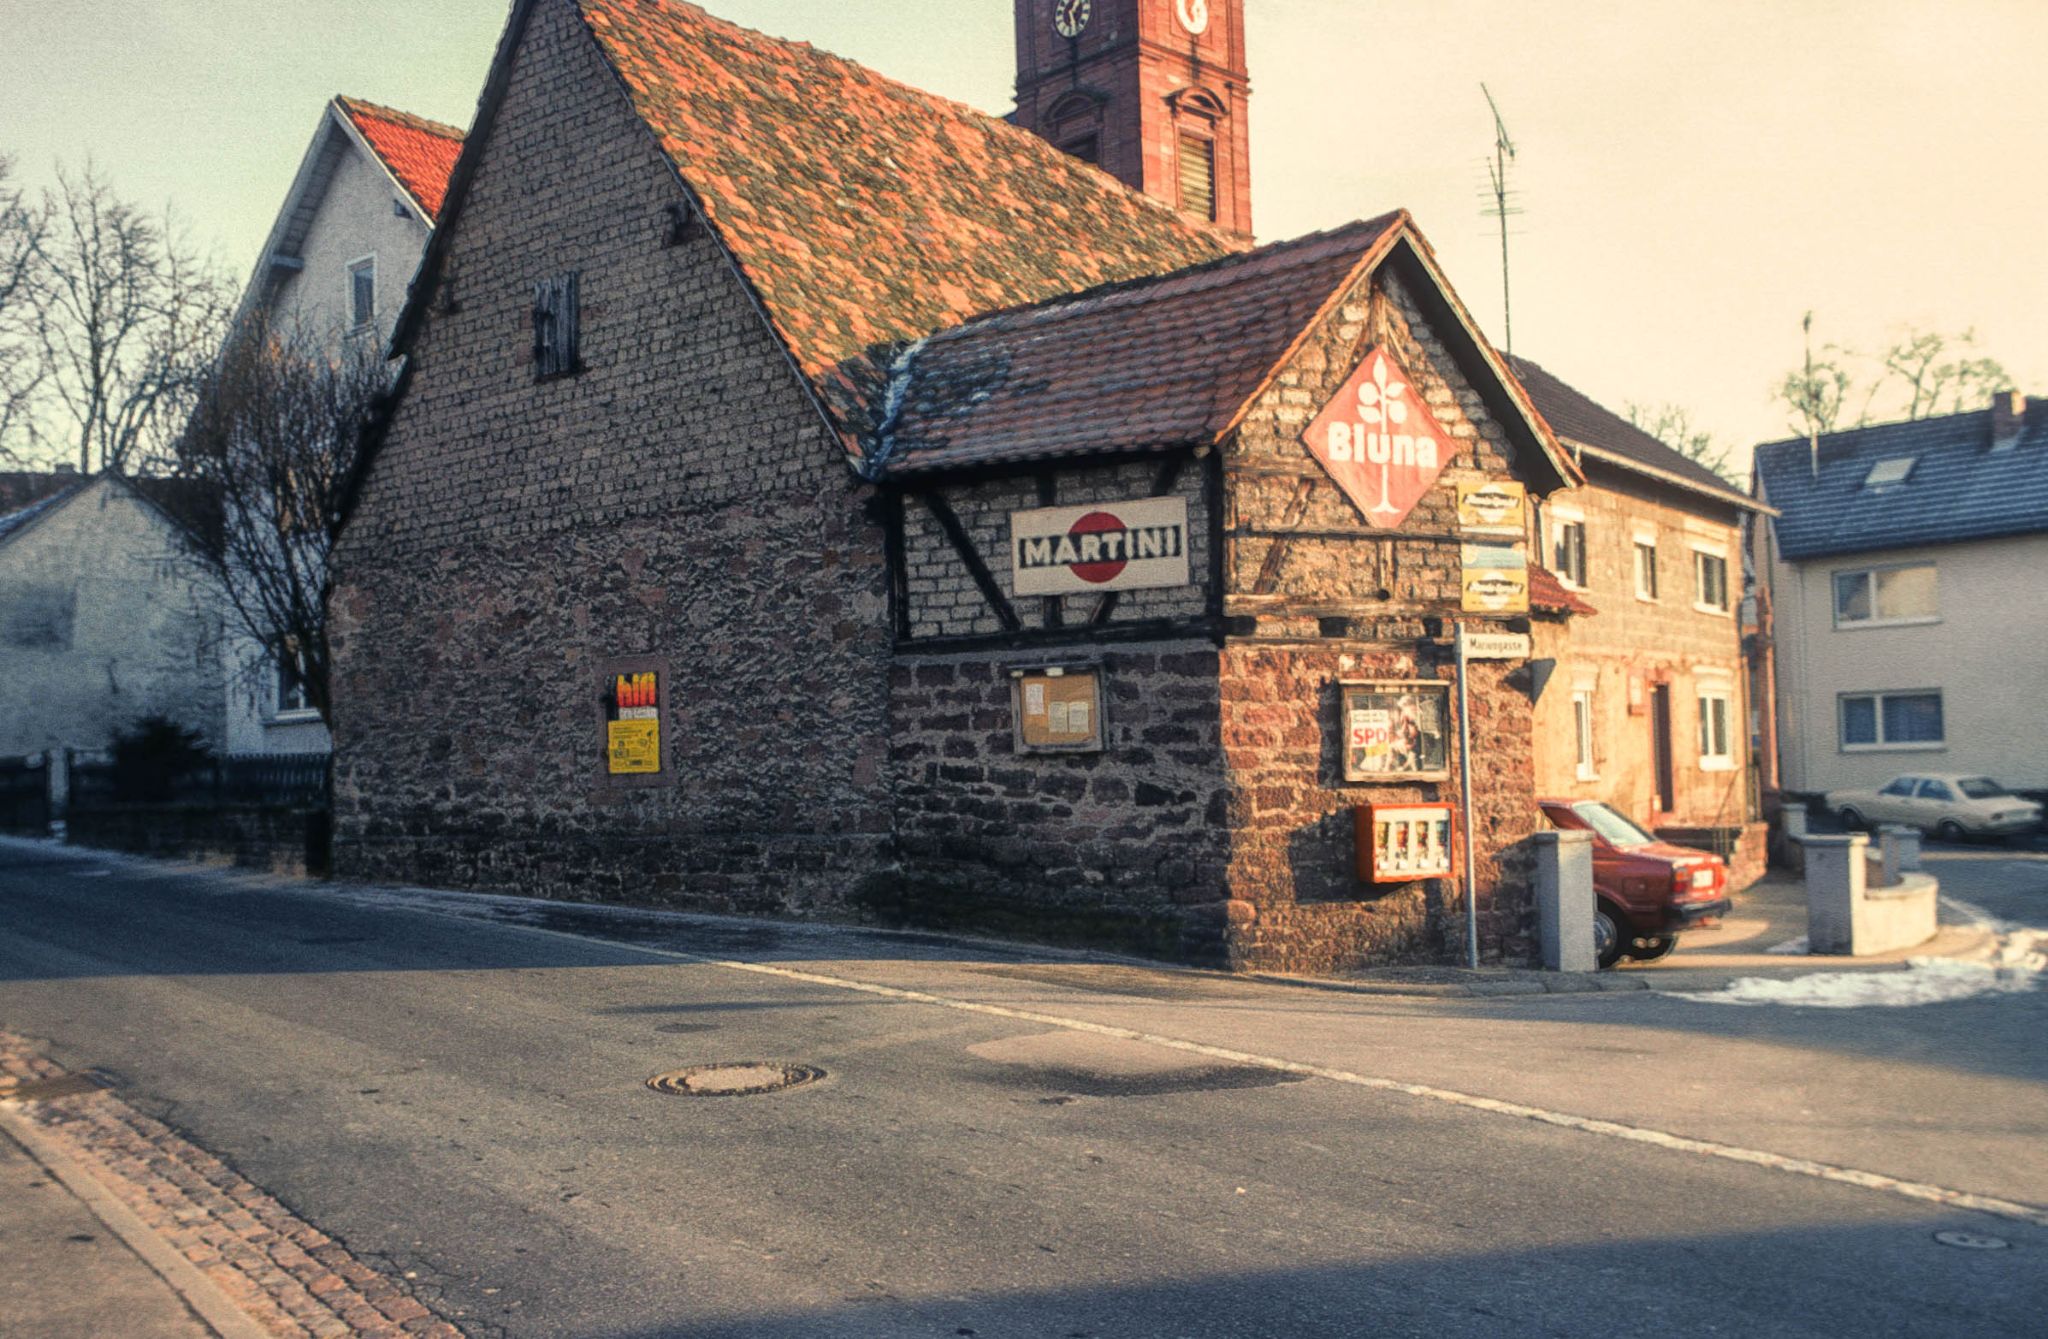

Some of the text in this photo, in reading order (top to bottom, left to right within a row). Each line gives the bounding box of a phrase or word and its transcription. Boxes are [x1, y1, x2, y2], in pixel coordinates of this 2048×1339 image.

[1327, 421, 1438, 468] Bluna
[1024, 526, 1176, 567] MARTINI
[1352, 726, 1388, 746] SPD
